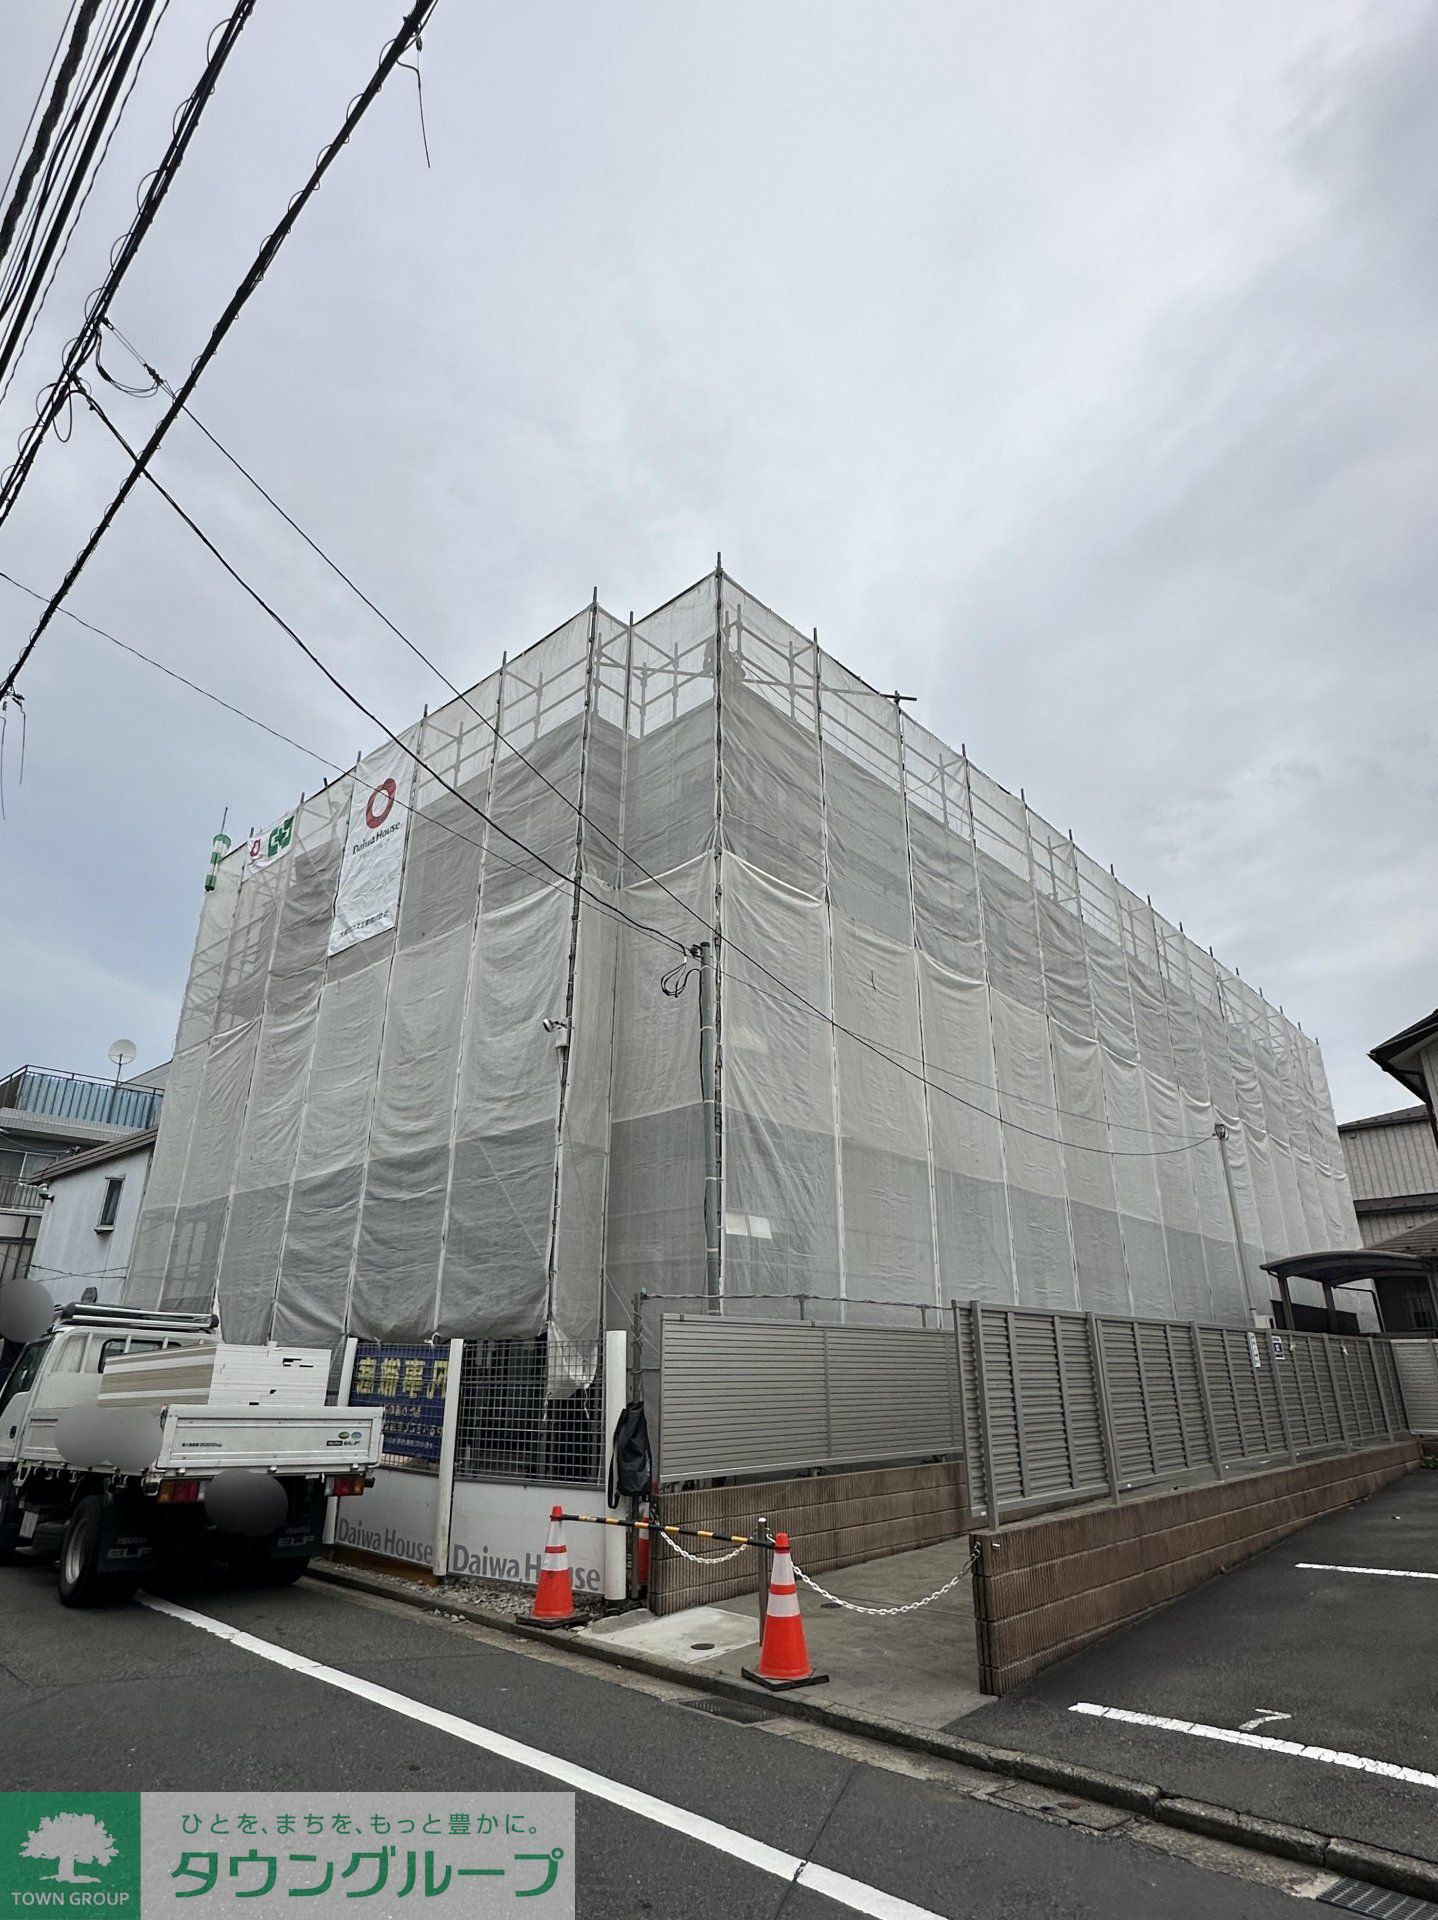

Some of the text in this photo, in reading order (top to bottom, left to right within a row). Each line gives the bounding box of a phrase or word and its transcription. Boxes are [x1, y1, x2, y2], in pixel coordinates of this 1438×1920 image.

[352, 822, 401, 855] Daiwa House
[107, 1547, 152, 1559] ELF
[338, 1517, 433, 1565] Daiwa House
[453, 1544, 601, 1591] Daiwa Hse
